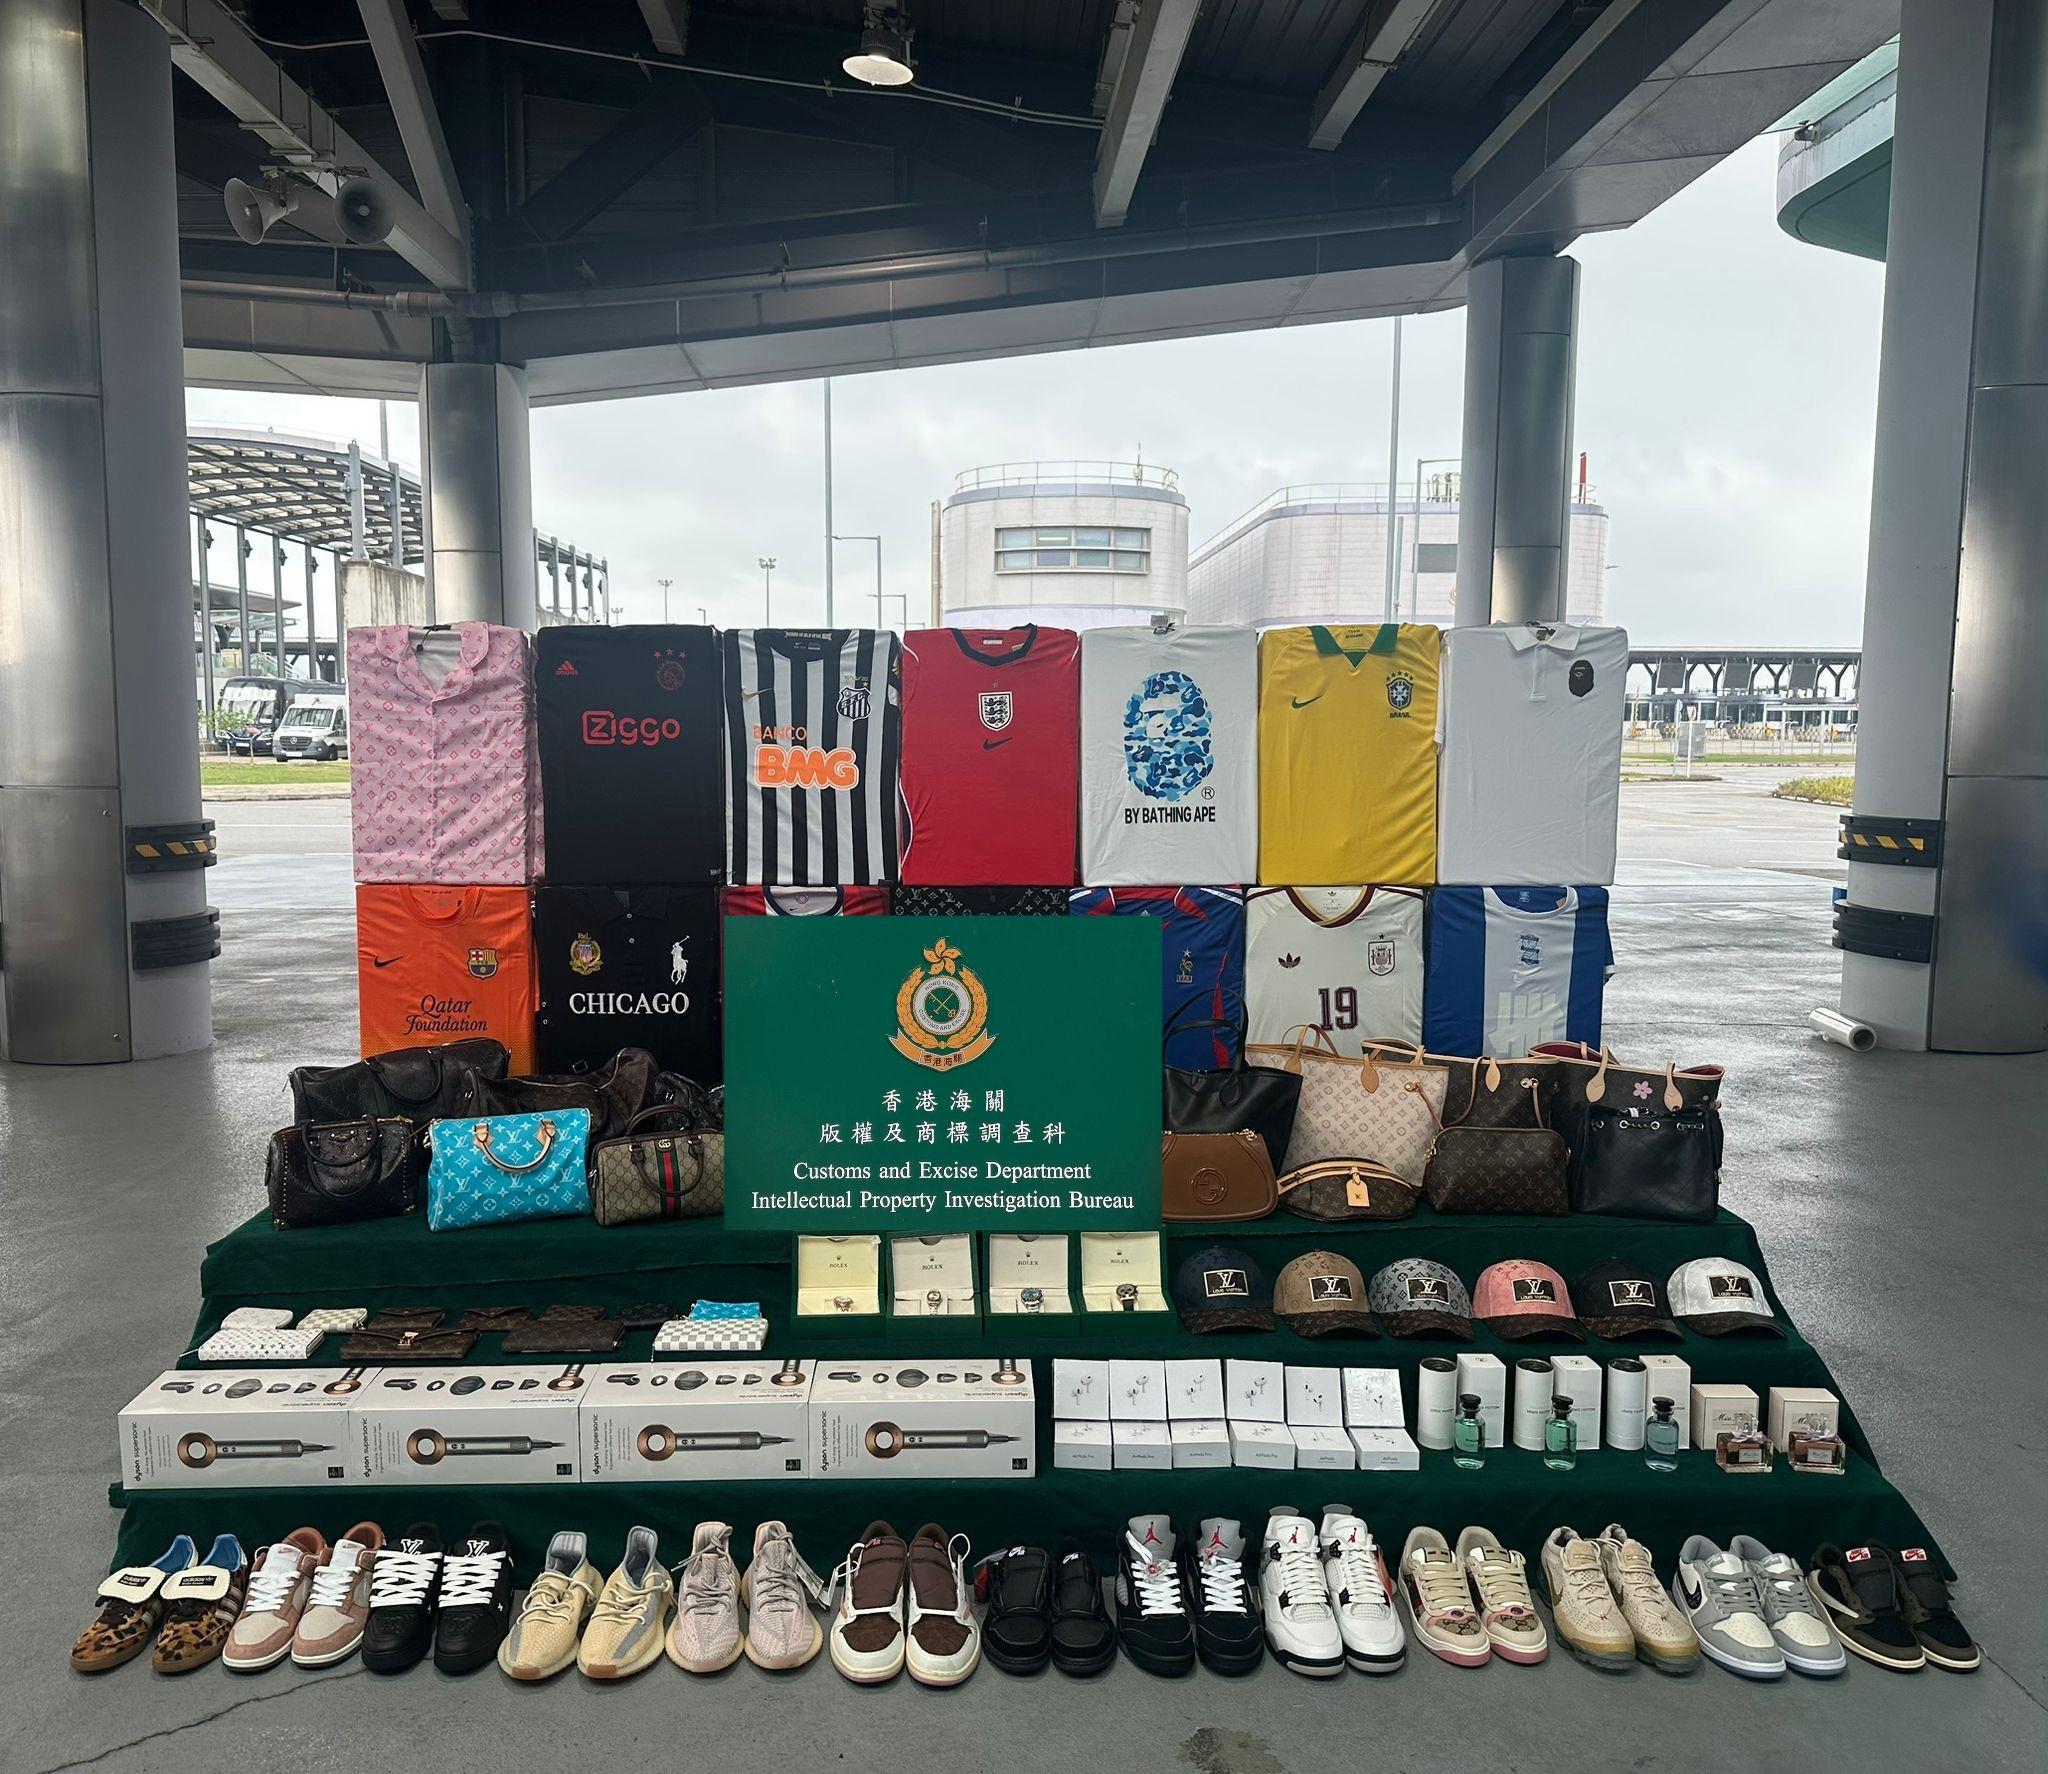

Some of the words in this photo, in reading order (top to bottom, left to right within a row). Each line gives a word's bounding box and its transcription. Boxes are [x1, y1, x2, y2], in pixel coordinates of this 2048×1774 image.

[584, 712, 681, 746] Ziggo
[752, 725, 807, 741] BANCO
[756, 745, 858, 789] BMG
[1125, 808, 1140, 824] BY
[1143, 807, 1191, 823] BATHING
[1194, 806, 1215, 822] APE
[924, 981, 941, 991] HONG
[942, 981, 959, 991] KONG
[421, 995, 472, 1019] Qatar
[569, 992, 689, 1014] CHICAGO
[1318, 986, 1358, 1031] 19
[404, 1015, 488, 1036] Foundation
[918, 1009, 940, 1030] CUSTOMS
[952, 1008, 966, 1028] EXCISE
[881, 1089, 1005, 1112] 香港海關
[819, 1121, 1066, 1145] 版權及商標調查科
[793, 1162, 871, 1181] Customs
[880, 1162, 910, 1180] and
[919, 1162, 978, 1180] Excise
[986, 1162, 1092, 1184] Department
[752, 1191, 852, 1209] Intellectual
[860, 1192, 937, 1213] Property
[945, 1191, 1059, 1213] Investigation
[1069, 1193, 1134, 1209] Bureau
[132, 1421, 140, 1457] supersonic
[361, 1417, 369, 1454] supersonic
[592, 1414, 600, 1450] supersonic
[821, 1410, 829, 1447] supersonic
[134, 1460, 143, 1481] dyson
[363, 1456, 372, 1477] dyson
[593, 1453, 601, 1474] dyson
[821, 1450, 829, 1471] dyson
